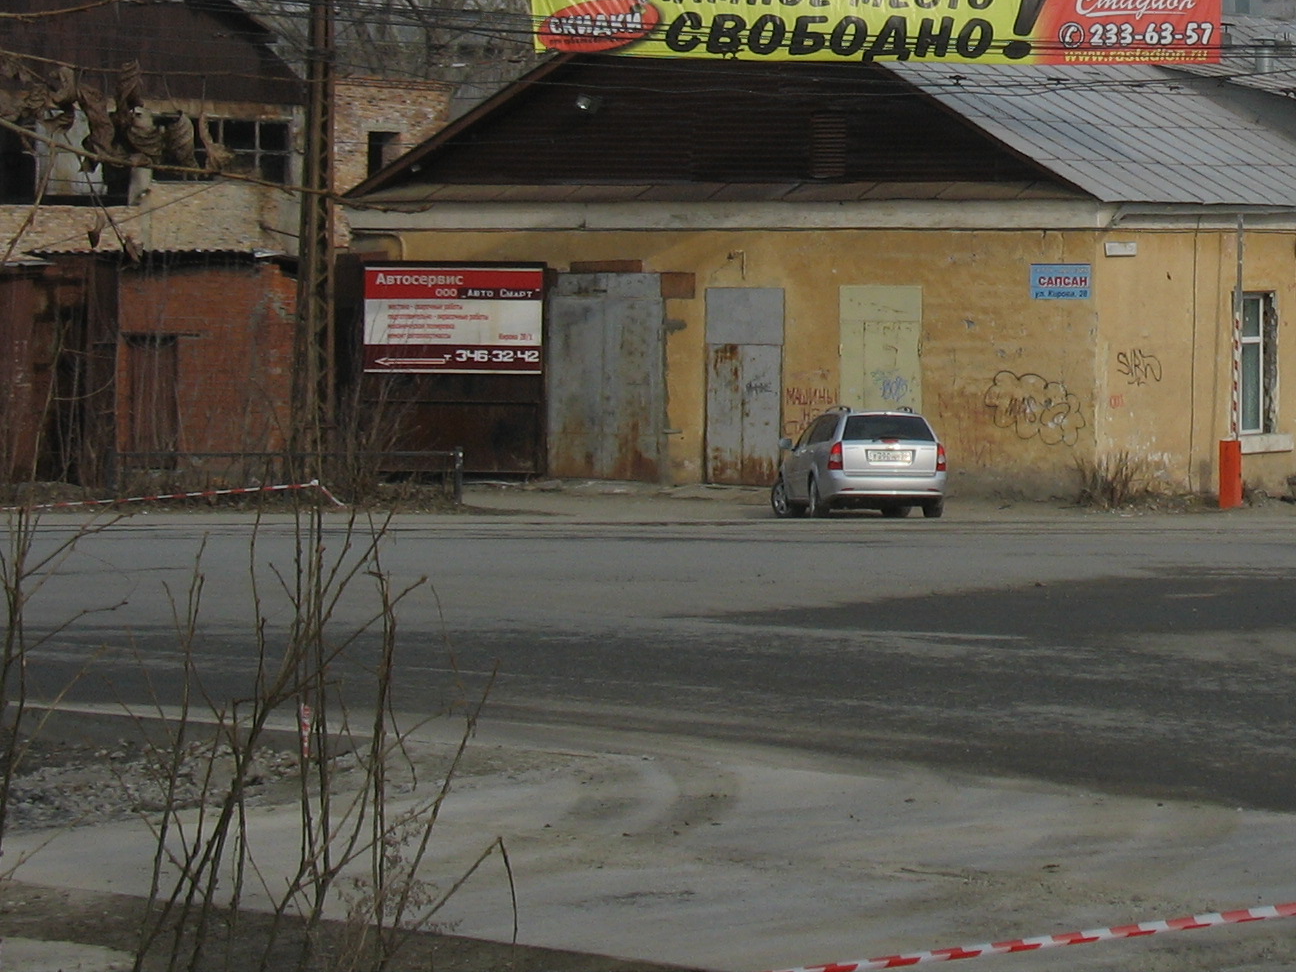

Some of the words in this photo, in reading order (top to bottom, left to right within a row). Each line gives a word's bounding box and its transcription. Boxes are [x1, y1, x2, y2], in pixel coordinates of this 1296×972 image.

[549, 12, 643, 36] СКИДКИ
[1088, 21, 1214, 46] 233-63-57
[375, 273, 464, 287] Автосервис
[1038, 276, 1088, 286] САПСАН
[435, 288, 458, 297] ООО
[785, 387, 838, 405] МАШИНЫ
